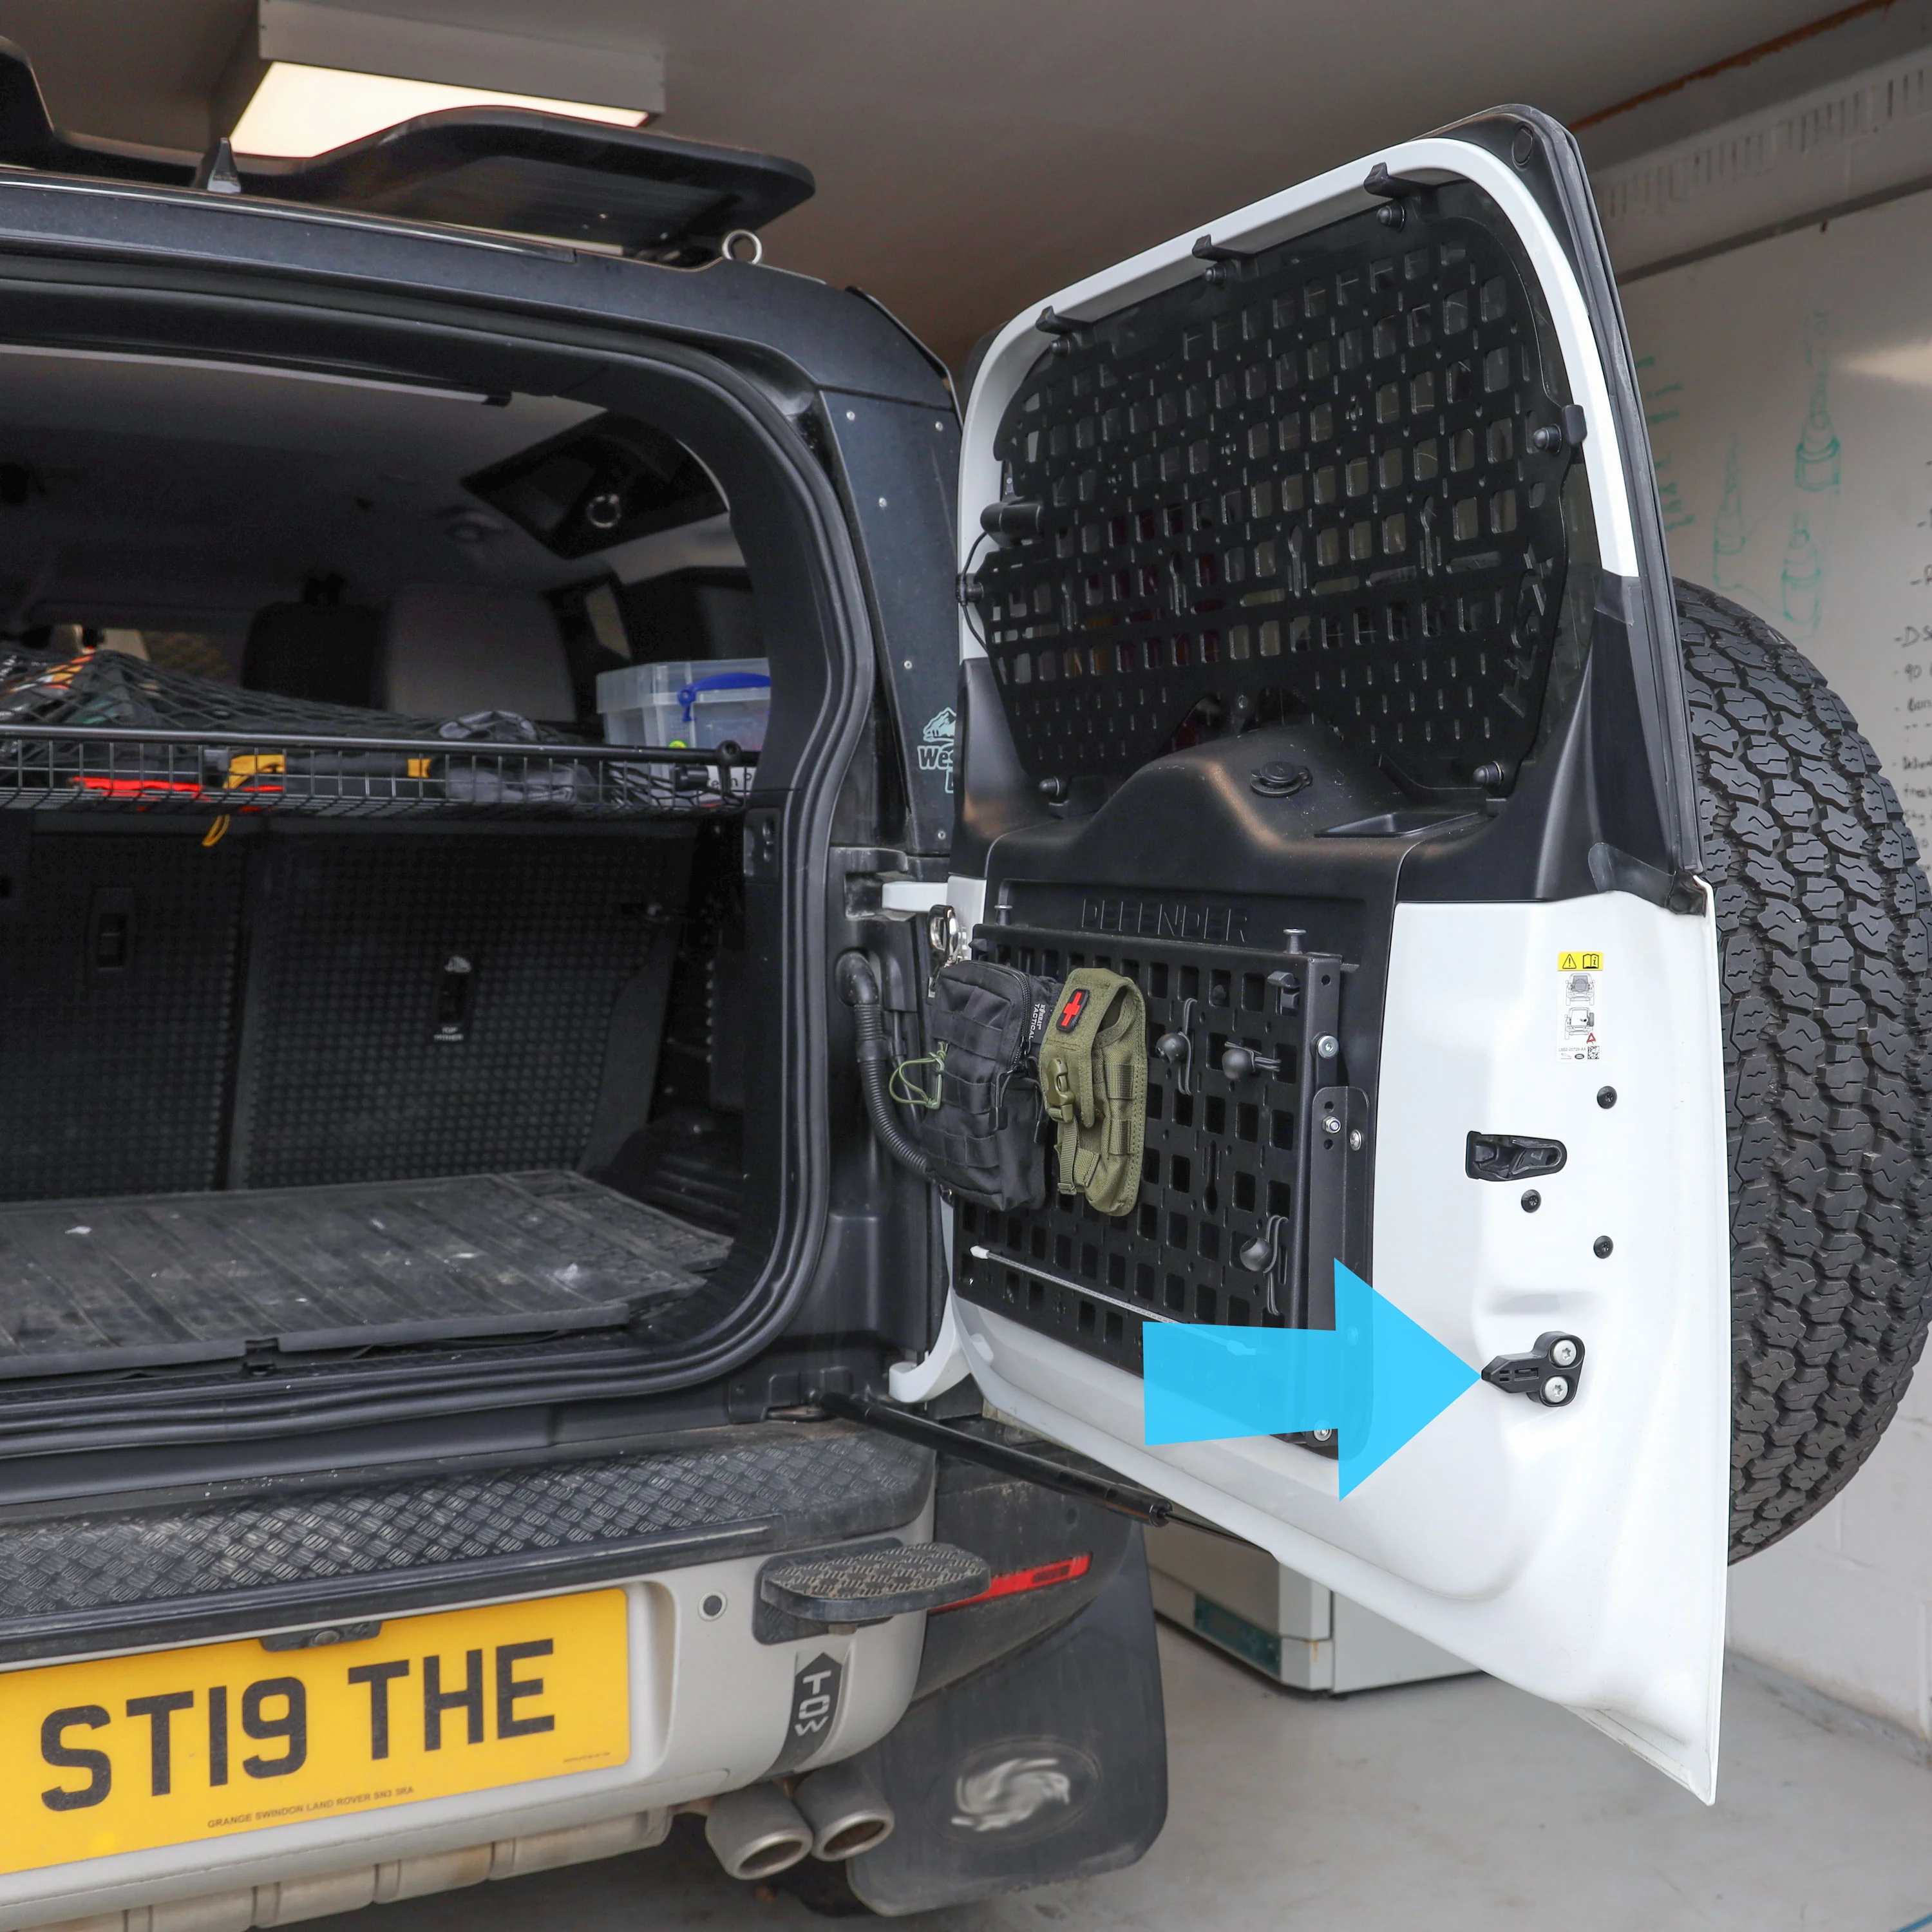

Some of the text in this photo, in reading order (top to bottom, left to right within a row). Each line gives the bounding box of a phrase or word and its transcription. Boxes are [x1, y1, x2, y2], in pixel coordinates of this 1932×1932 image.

[1081, 898, 1247, 943] DEFENDER
[1028, 1003, 1041, 1039] TACTICAL
[348, 1638, 555, 1761] THE
[795, 1670, 831, 1736] TOW
[207, 1813, 252, 1828] GRANGE
[255, 1804, 303, 1820] SWINDON
[307, 1799, 333, 1812] LAND
[336, 1793, 370, 1806] ROVER
